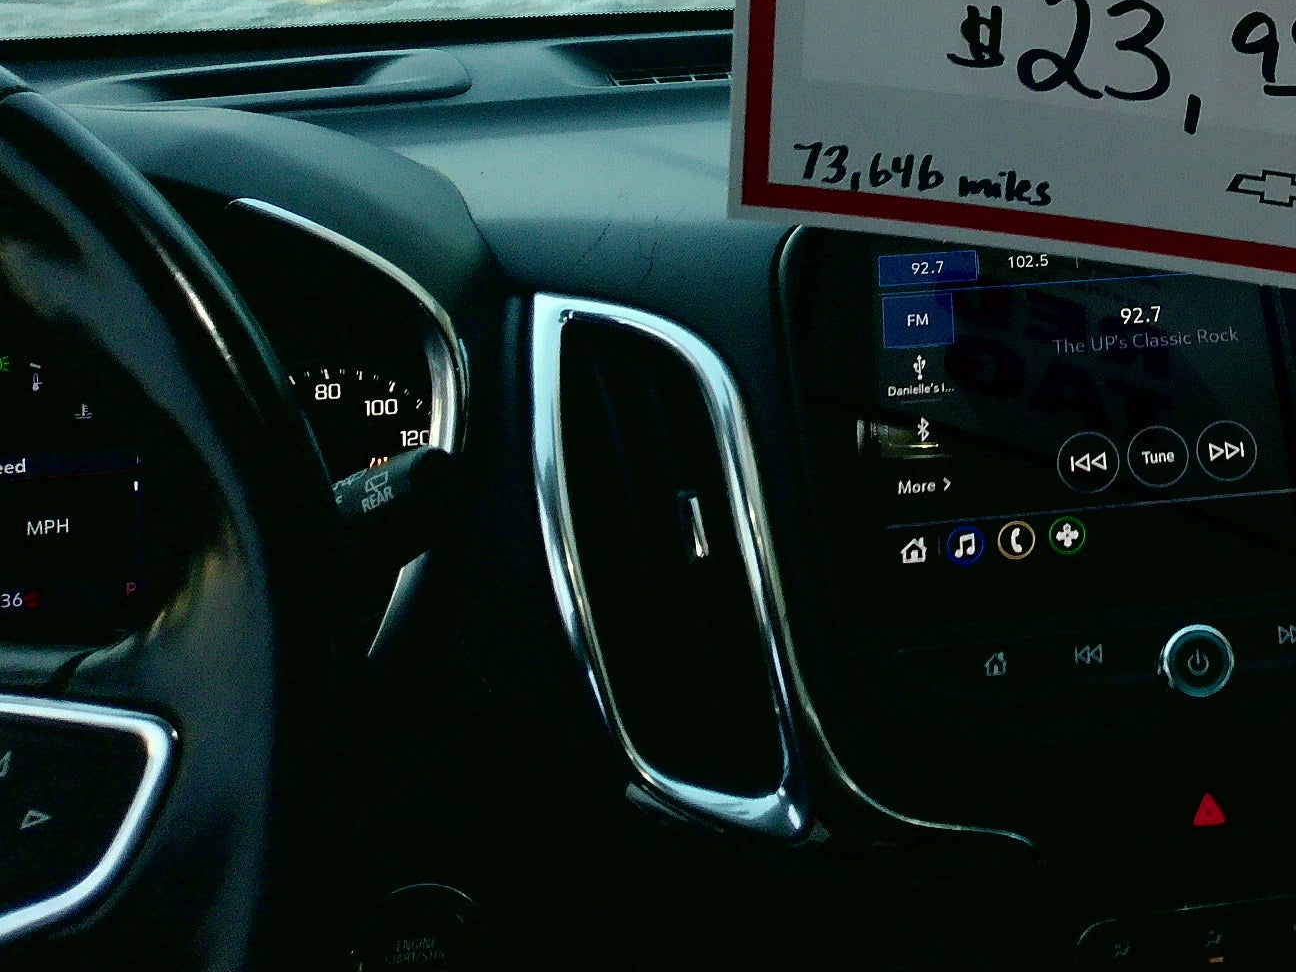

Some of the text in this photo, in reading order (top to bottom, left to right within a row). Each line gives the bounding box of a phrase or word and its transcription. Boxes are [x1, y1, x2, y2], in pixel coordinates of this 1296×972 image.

[794, 141, 1052, 206] 73,646 miles
[910, 260, 945, 276] 92.7
[1007, 254, 1050, 270] 102.5
[906, 313, 930, 328] FM
[1119, 305, 1162, 325] 92.7
[1052, 326, 1240, 354] The UP's Classic Rock
[314, 382, 342, 401] 80
[363, 398, 399, 417] 100
[1141, 449, 1176, 466] Tune
[897, 478, 937, 496] More
[360, 485, 396, 515] REAR
[25, 517, 70, 537] MPH
